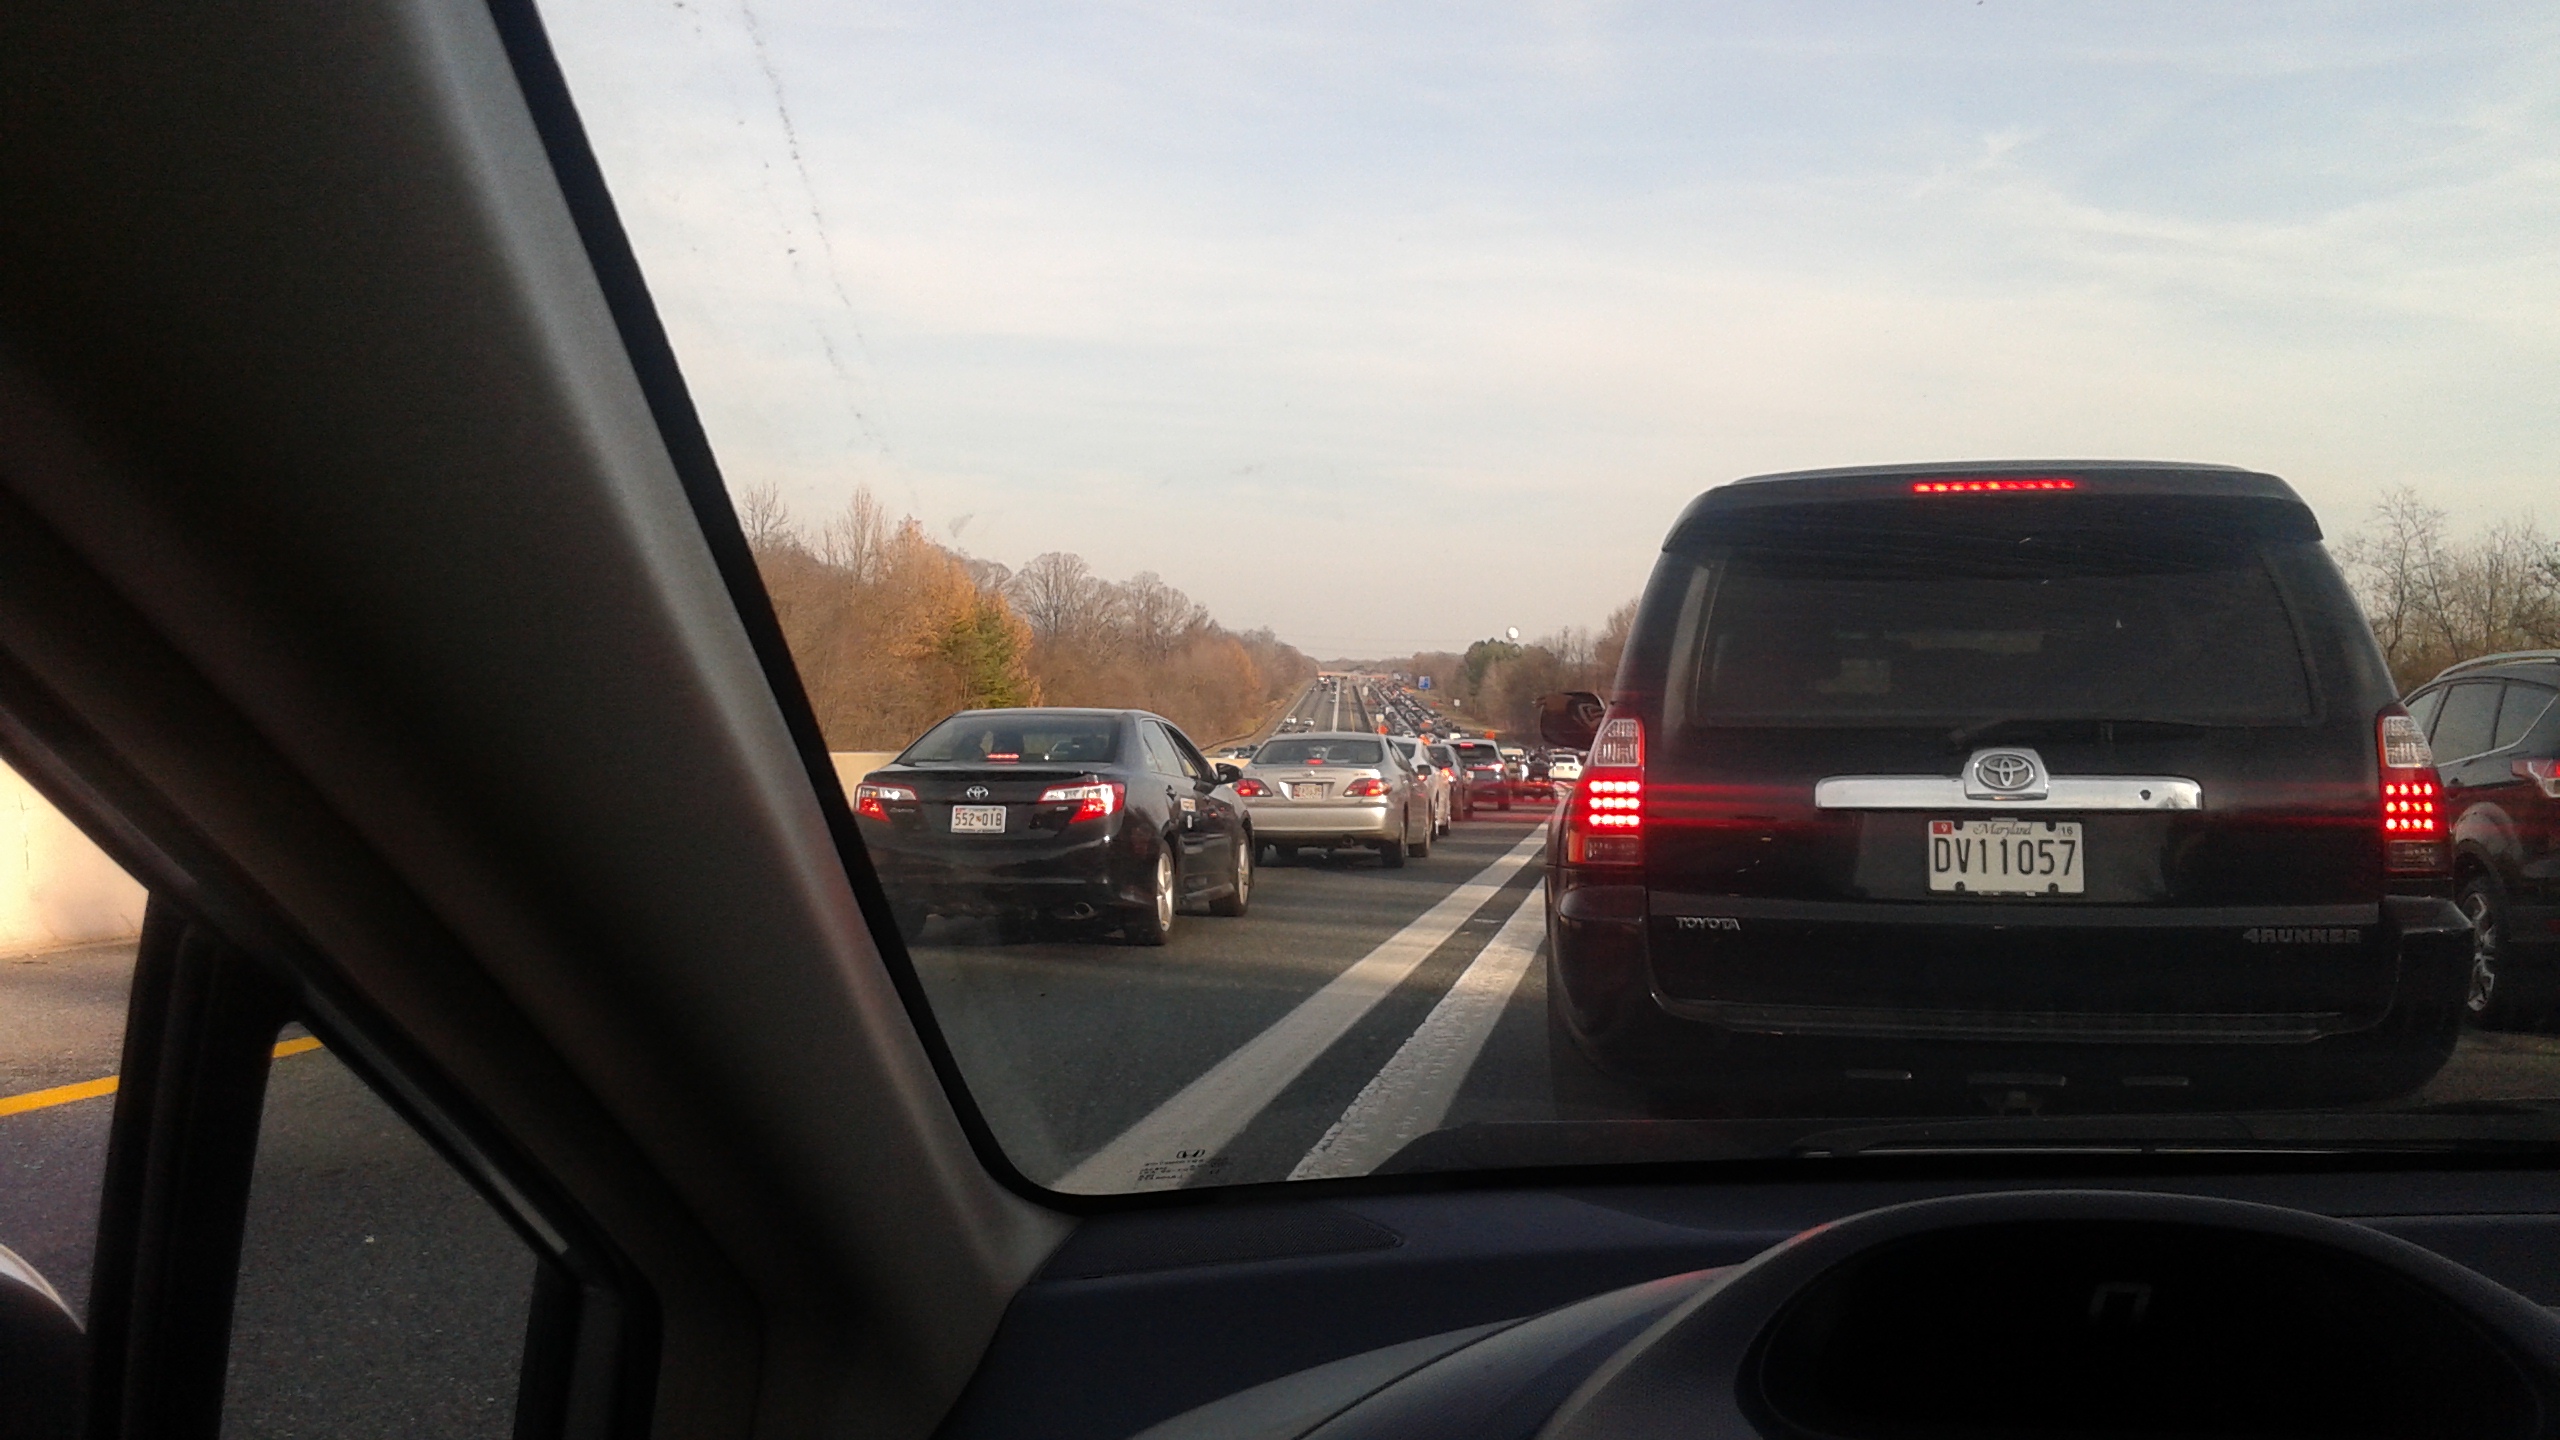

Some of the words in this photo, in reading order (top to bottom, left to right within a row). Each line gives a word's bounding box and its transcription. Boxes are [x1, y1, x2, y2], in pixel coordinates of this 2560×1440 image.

[1973, 821, 2033, 837] Maryland
[1934, 837, 2076, 876] DV11057
[1675, 916, 1741, 931] TOYOTA
[2242, 927, 2361, 943] 4RUNNER
